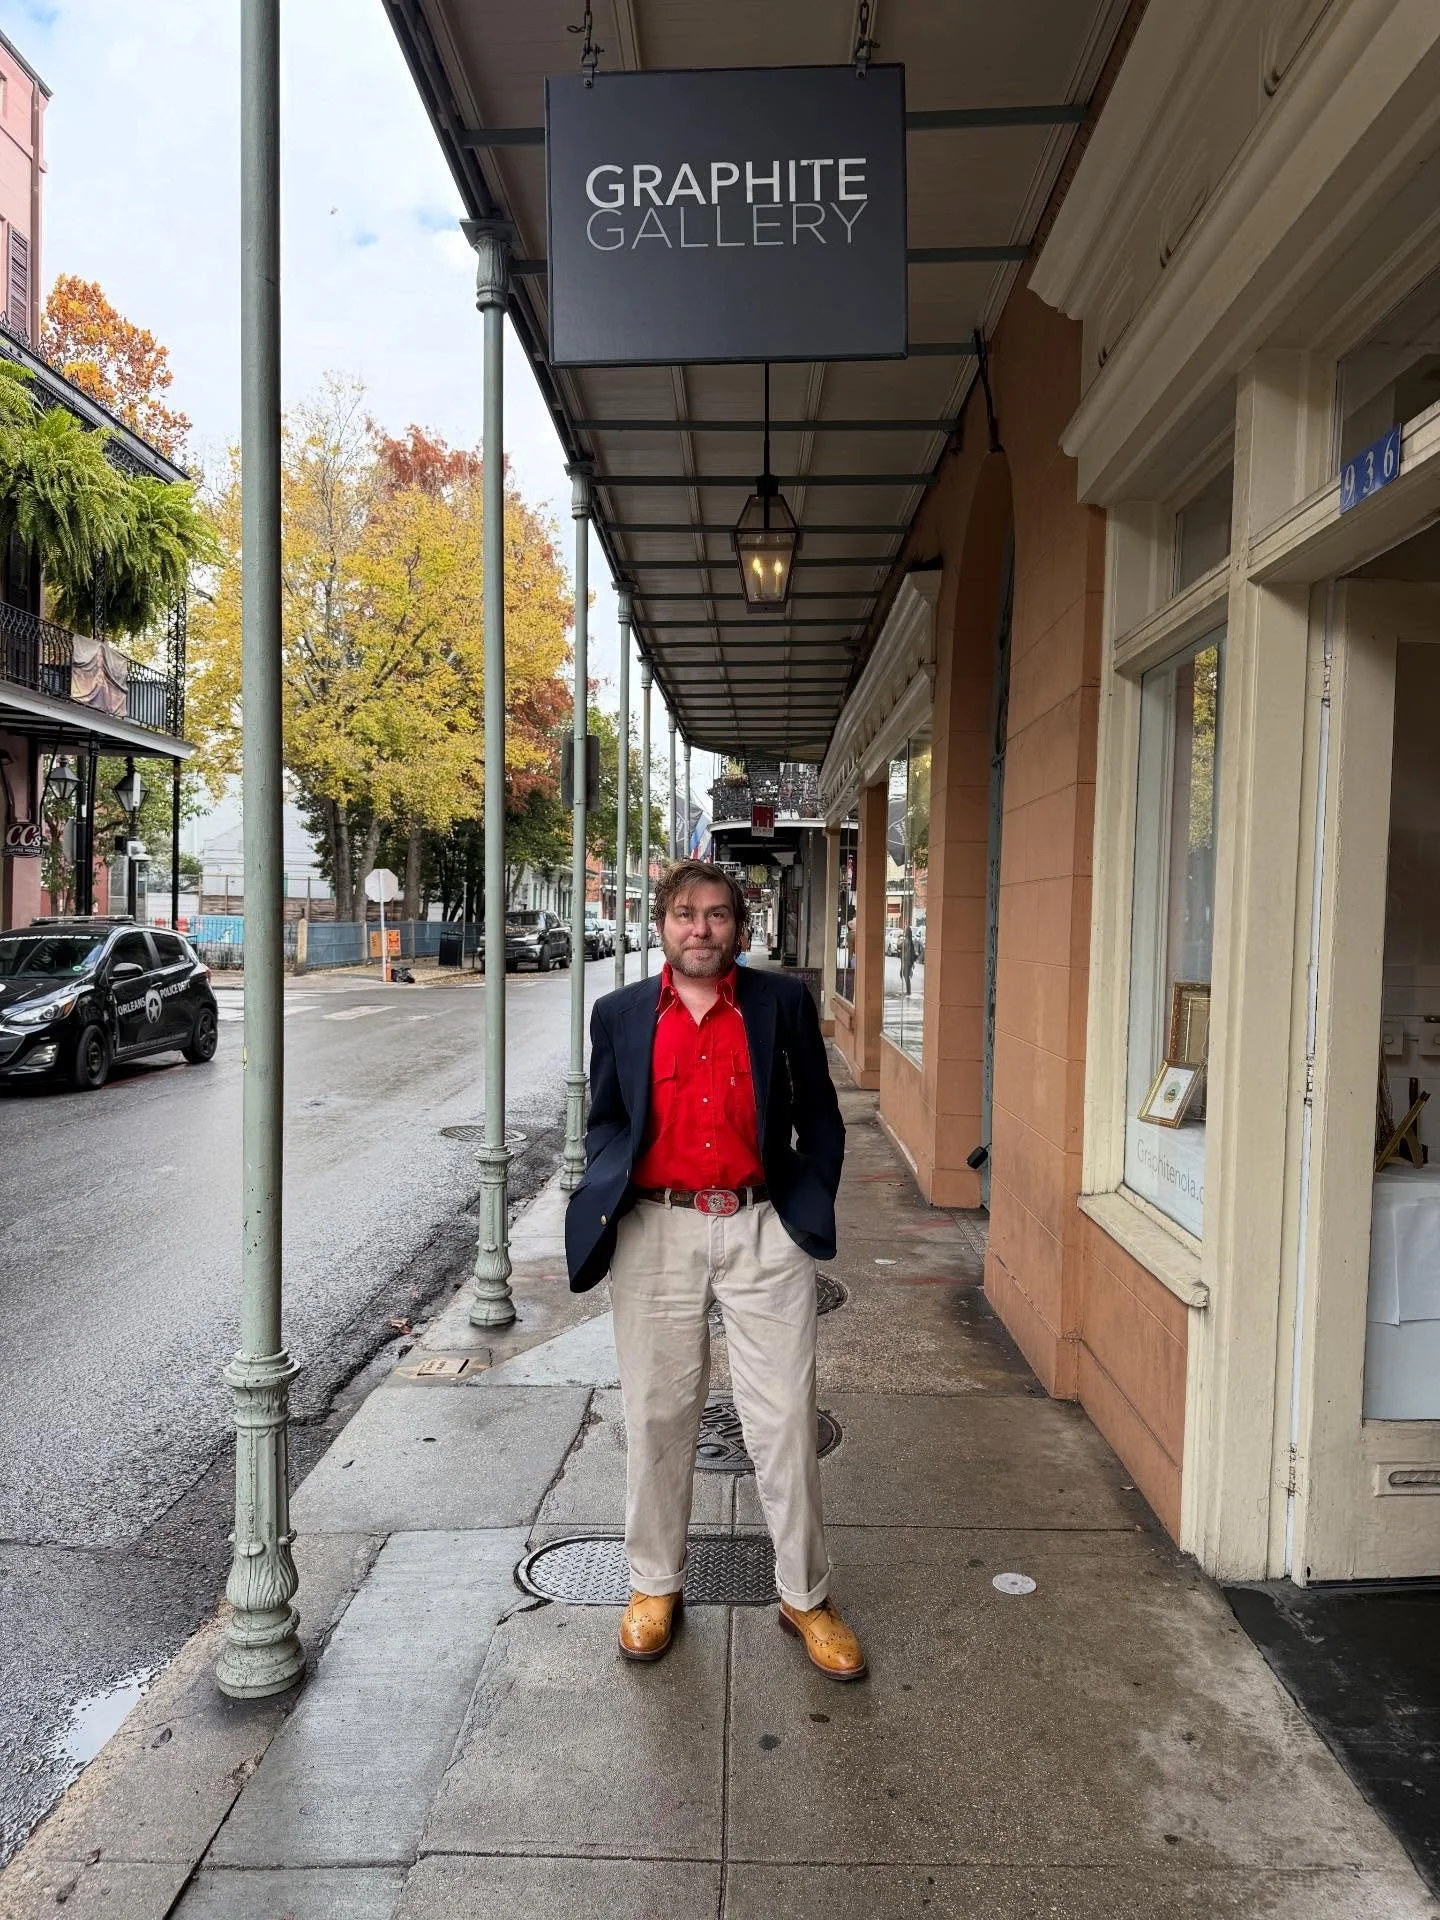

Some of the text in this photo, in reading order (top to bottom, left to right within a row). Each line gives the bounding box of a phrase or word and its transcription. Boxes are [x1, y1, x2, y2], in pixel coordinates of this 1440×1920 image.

[585, 157, 869, 209] GRAPHITE
[585, 201, 869, 251] GALLERY
[1343, 431, 1396, 505] 936
[117, 979, 191, 1016] ORLEANS POLICE DEPT
